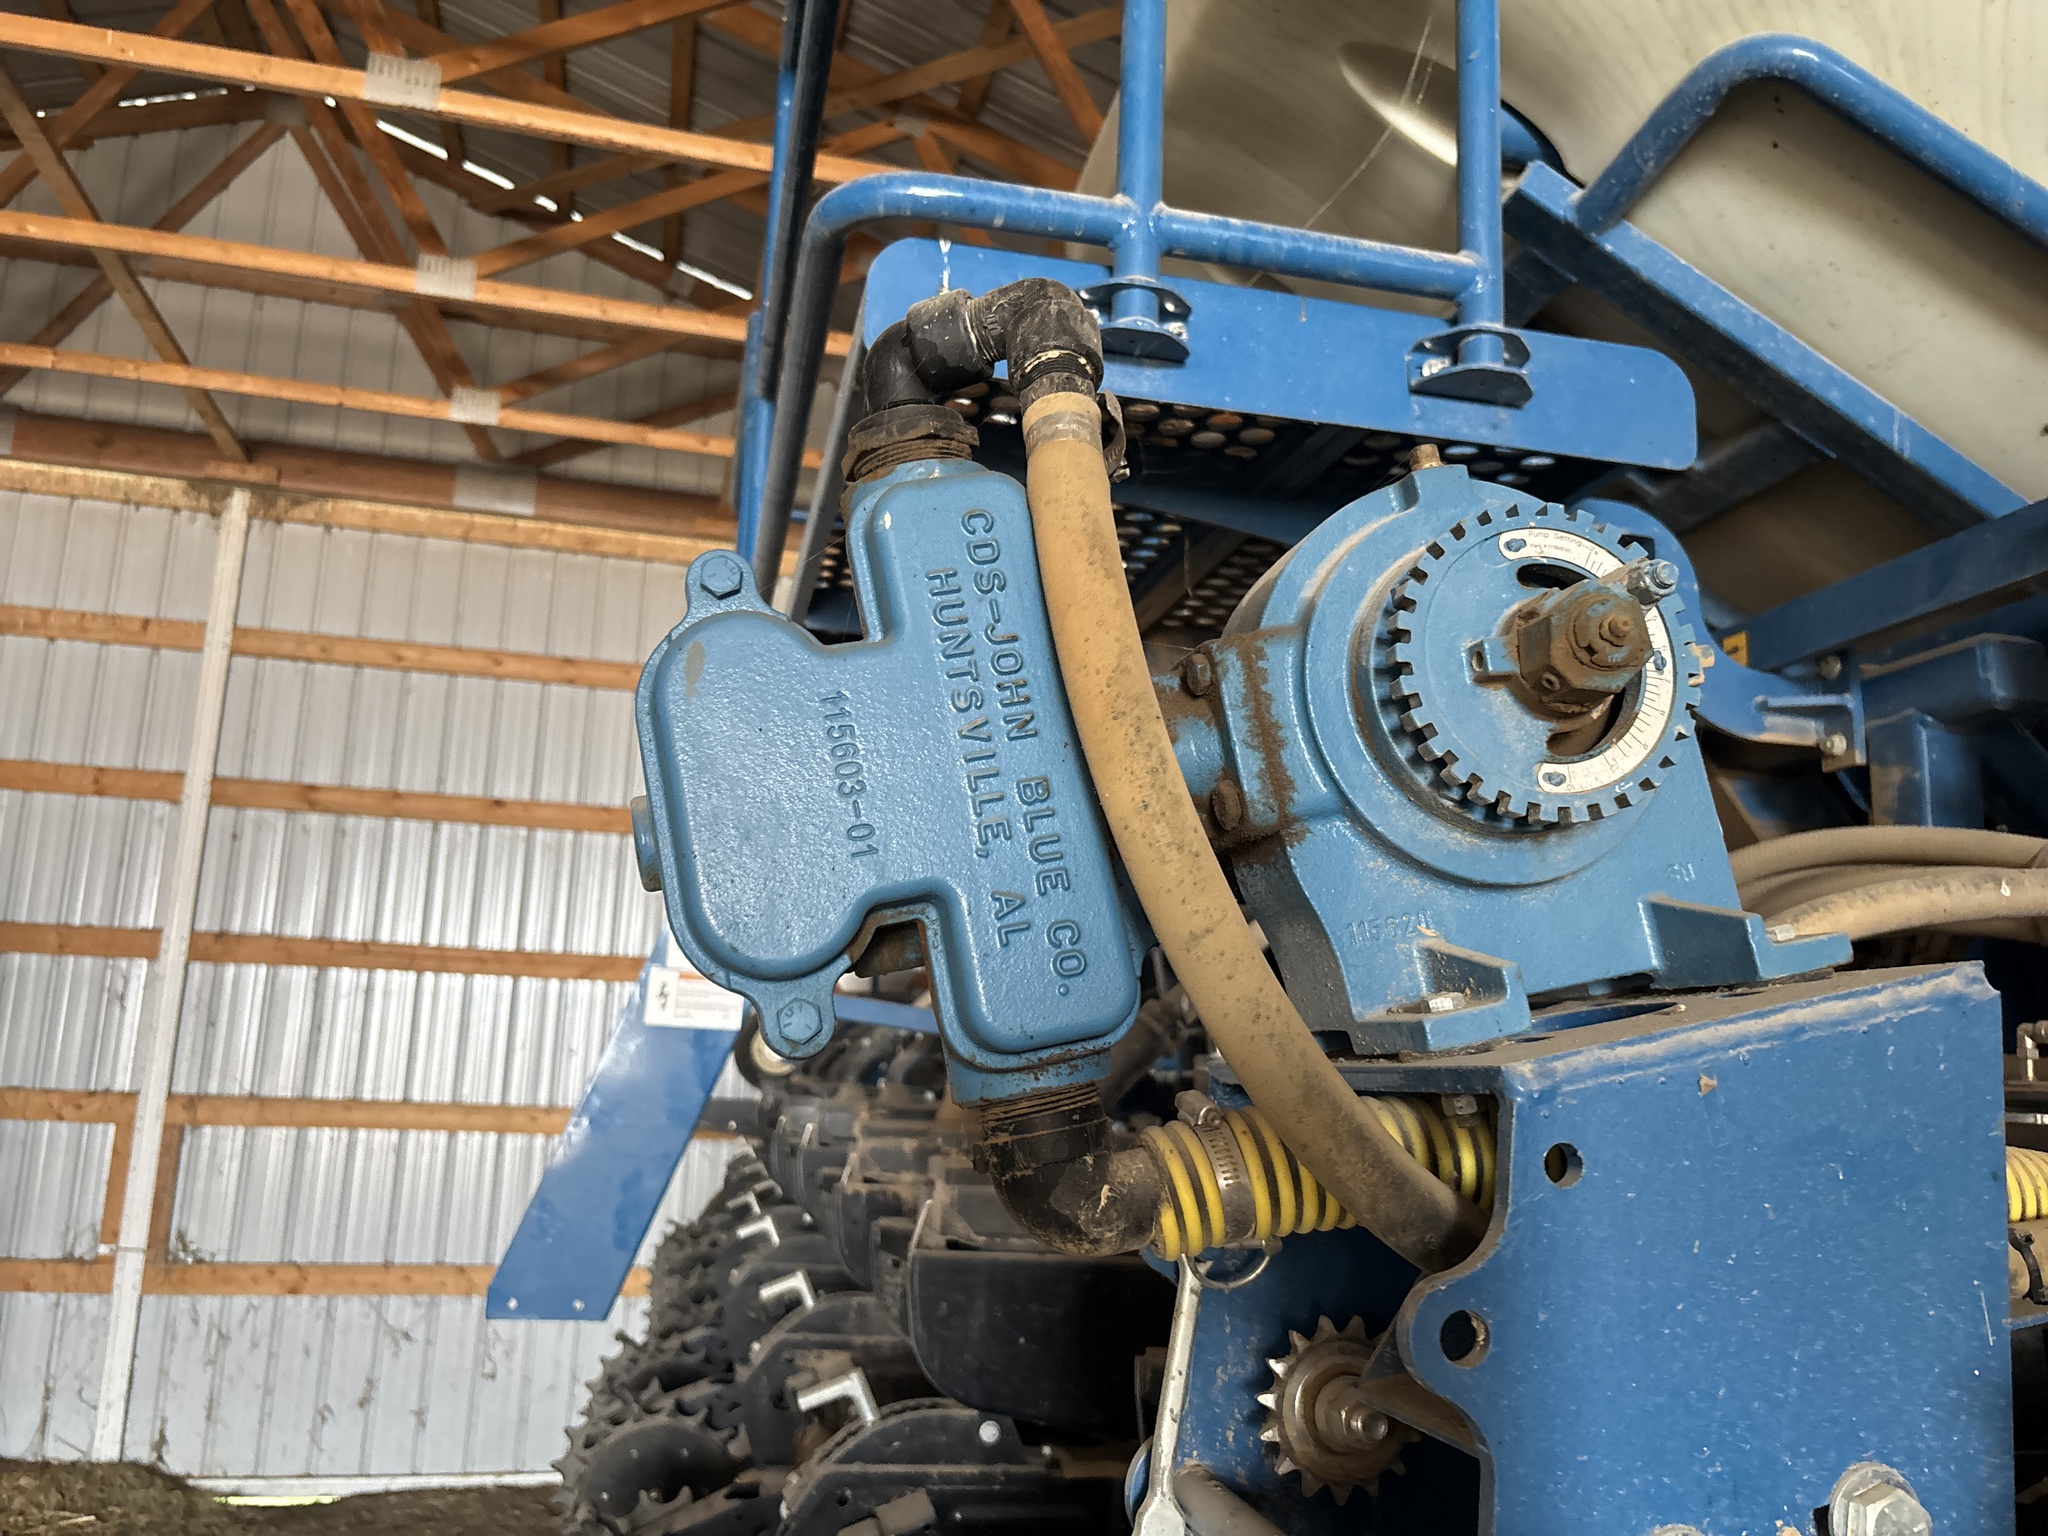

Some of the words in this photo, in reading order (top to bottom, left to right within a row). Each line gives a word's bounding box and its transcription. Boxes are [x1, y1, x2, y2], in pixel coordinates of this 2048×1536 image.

[1528, 530, 1549, 539] Pump
[820, 690, 880, 861] 115603-01
[925, 567, 1013, 860] HUNTSVILLE,
[990, 889, 1031, 949] AL
[960, 508, 1038, 742] CDS-JOHN
[1016, 775, 1071, 897] BLUE
[1045, 919, 1088, 997] CO.
